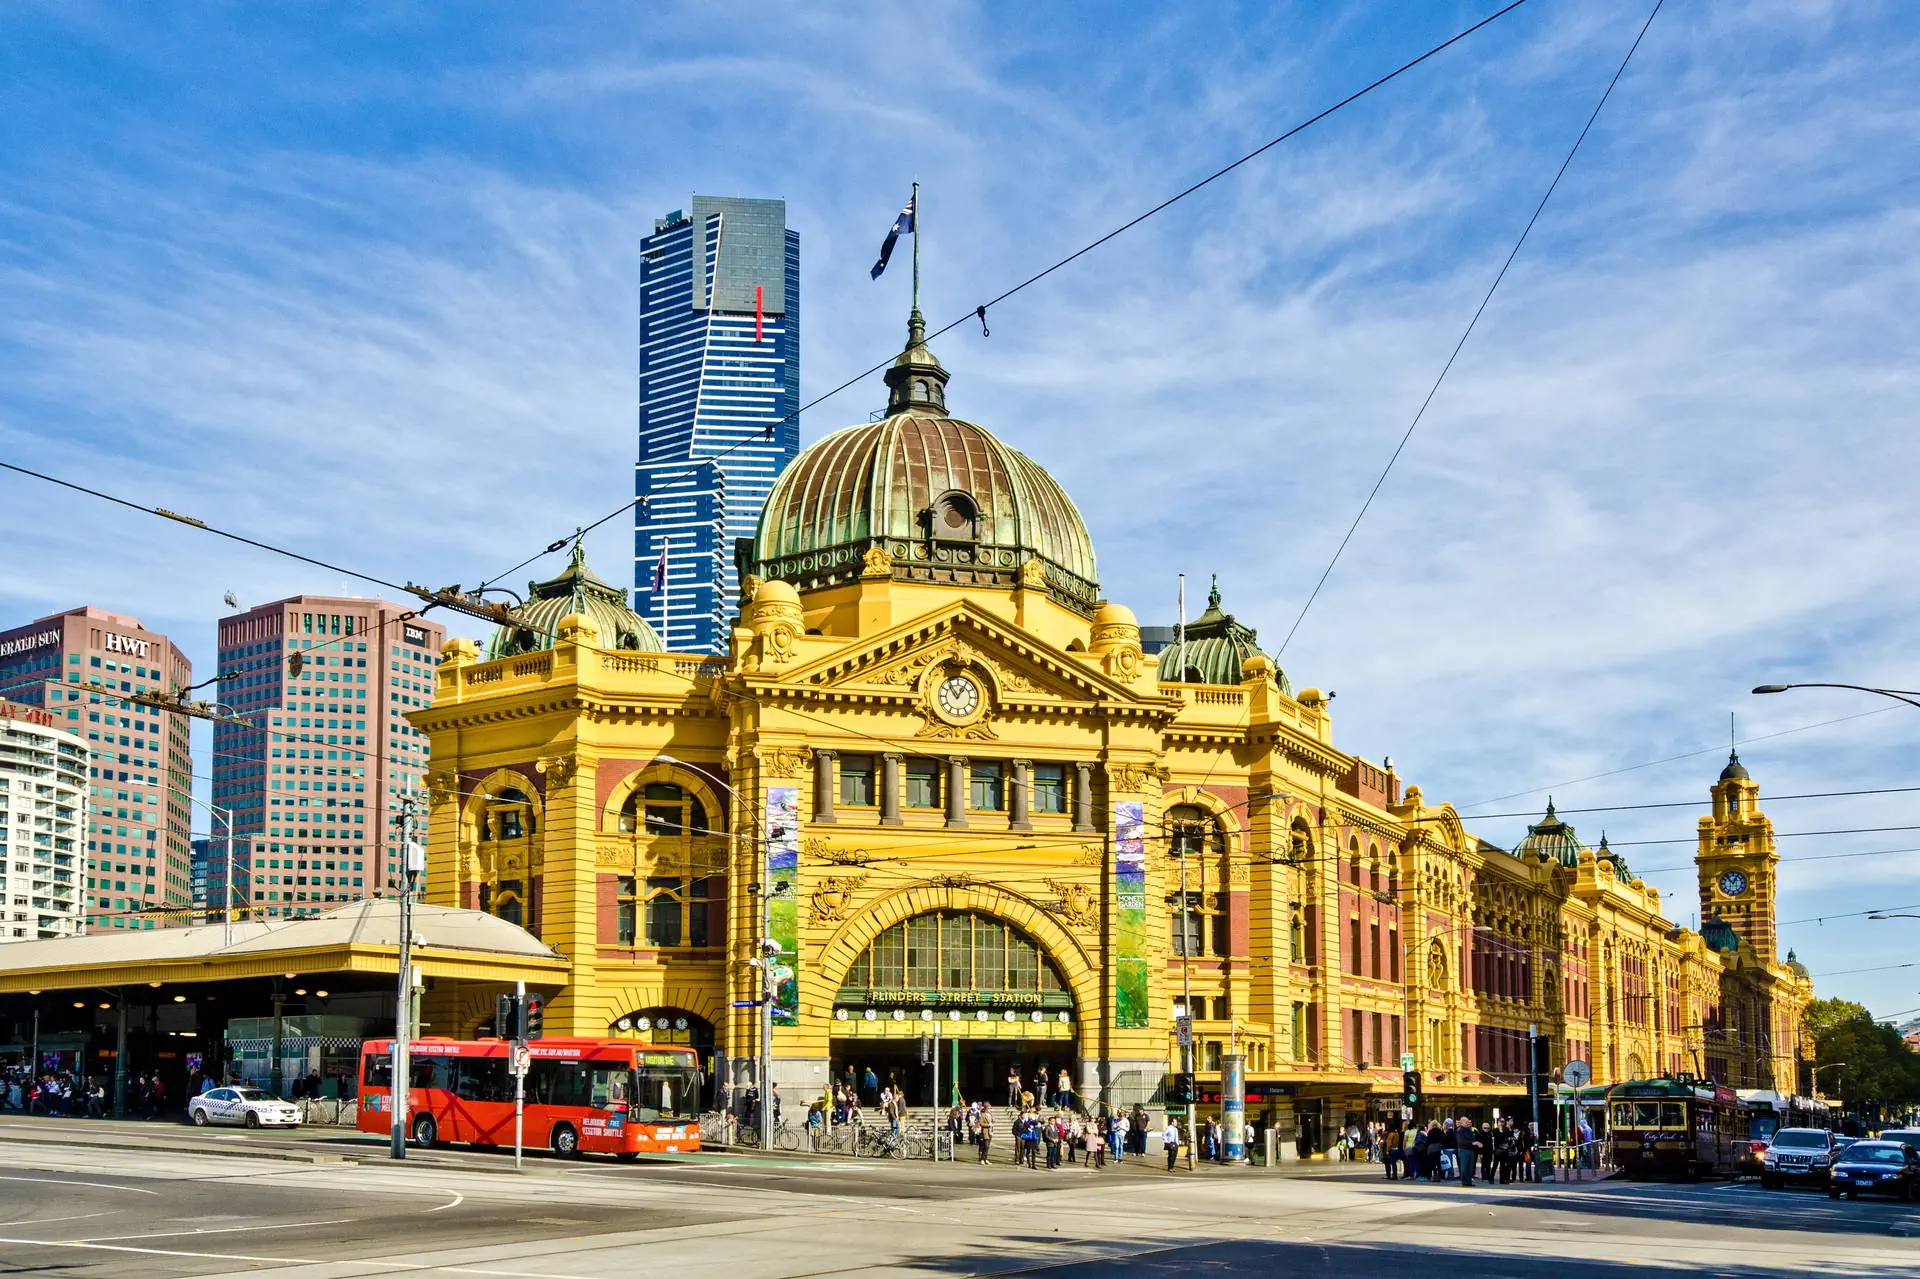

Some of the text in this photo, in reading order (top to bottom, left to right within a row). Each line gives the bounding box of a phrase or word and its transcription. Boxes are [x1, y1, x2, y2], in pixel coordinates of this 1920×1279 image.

[38, 629, 60, 647] SUN
[405, 626, 424, 641] IBM
[105, 632, 149, 657] HWT
[872, 990, 1042, 1004] FLINDERS STREET STATION
[603, 1129, 624, 1138] SHUTTLE
